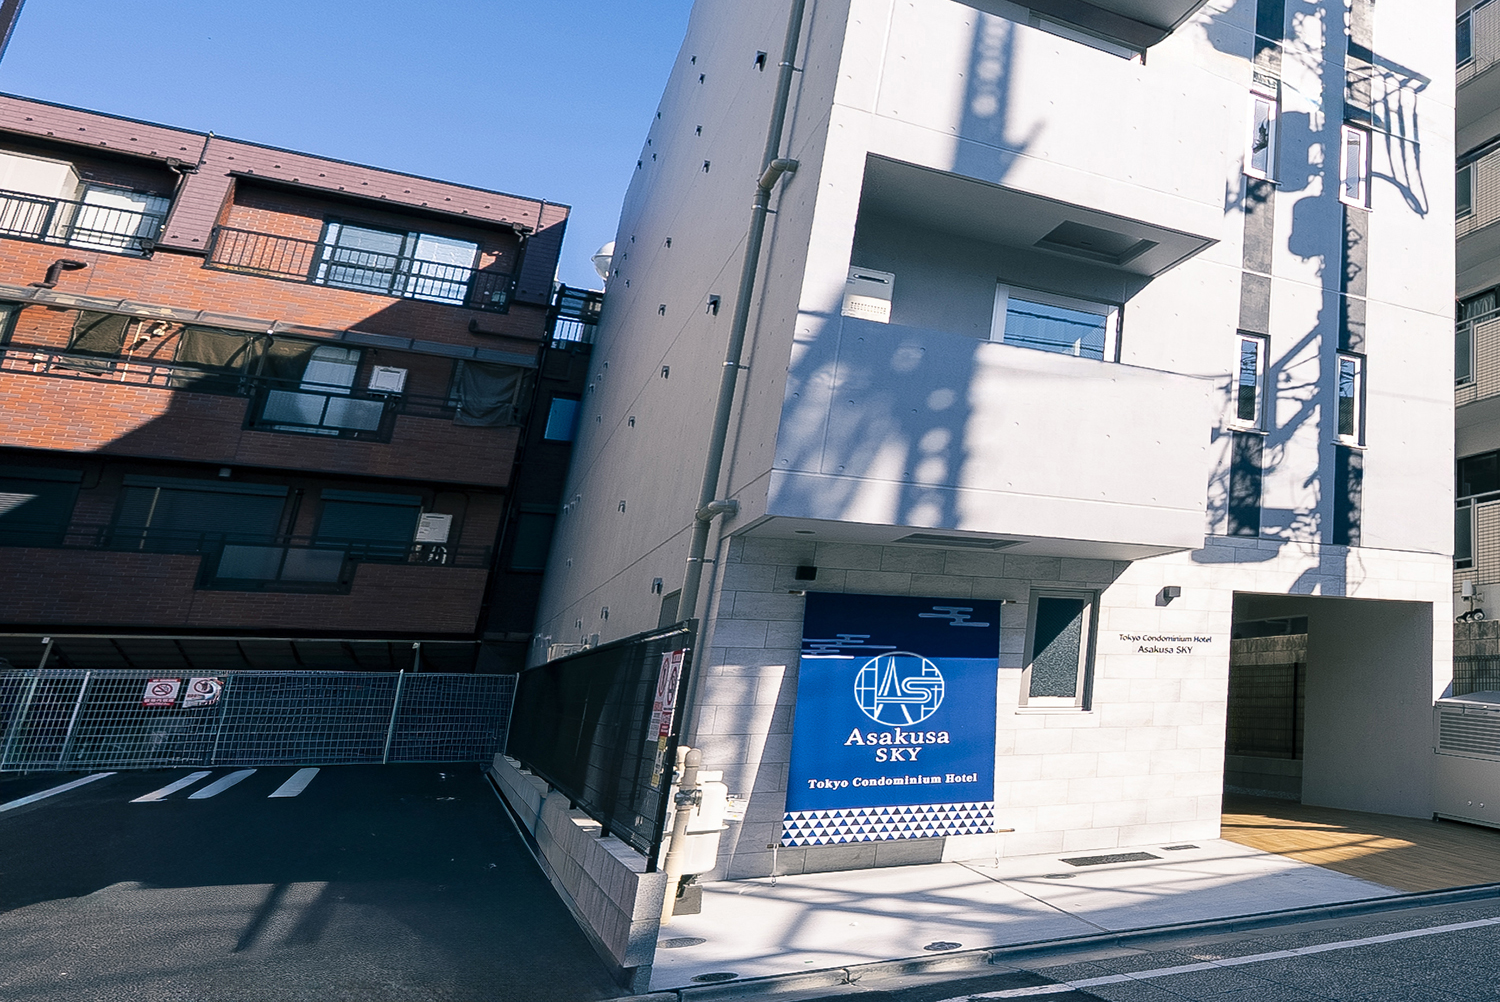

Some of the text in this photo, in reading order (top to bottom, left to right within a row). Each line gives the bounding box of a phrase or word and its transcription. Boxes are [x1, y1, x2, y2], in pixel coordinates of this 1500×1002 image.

[1119, 634, 1141, 642] Tokyo
[1142, 634, 1192, 642] Condominium
[1138, 645, 1193, 654] Asakusa SKY
[844, 727, 950, 746] Asakusa
[875, 747, 922, 762] SKY
[808, 772, 978, 790] Tokyo Condominium Hotel
